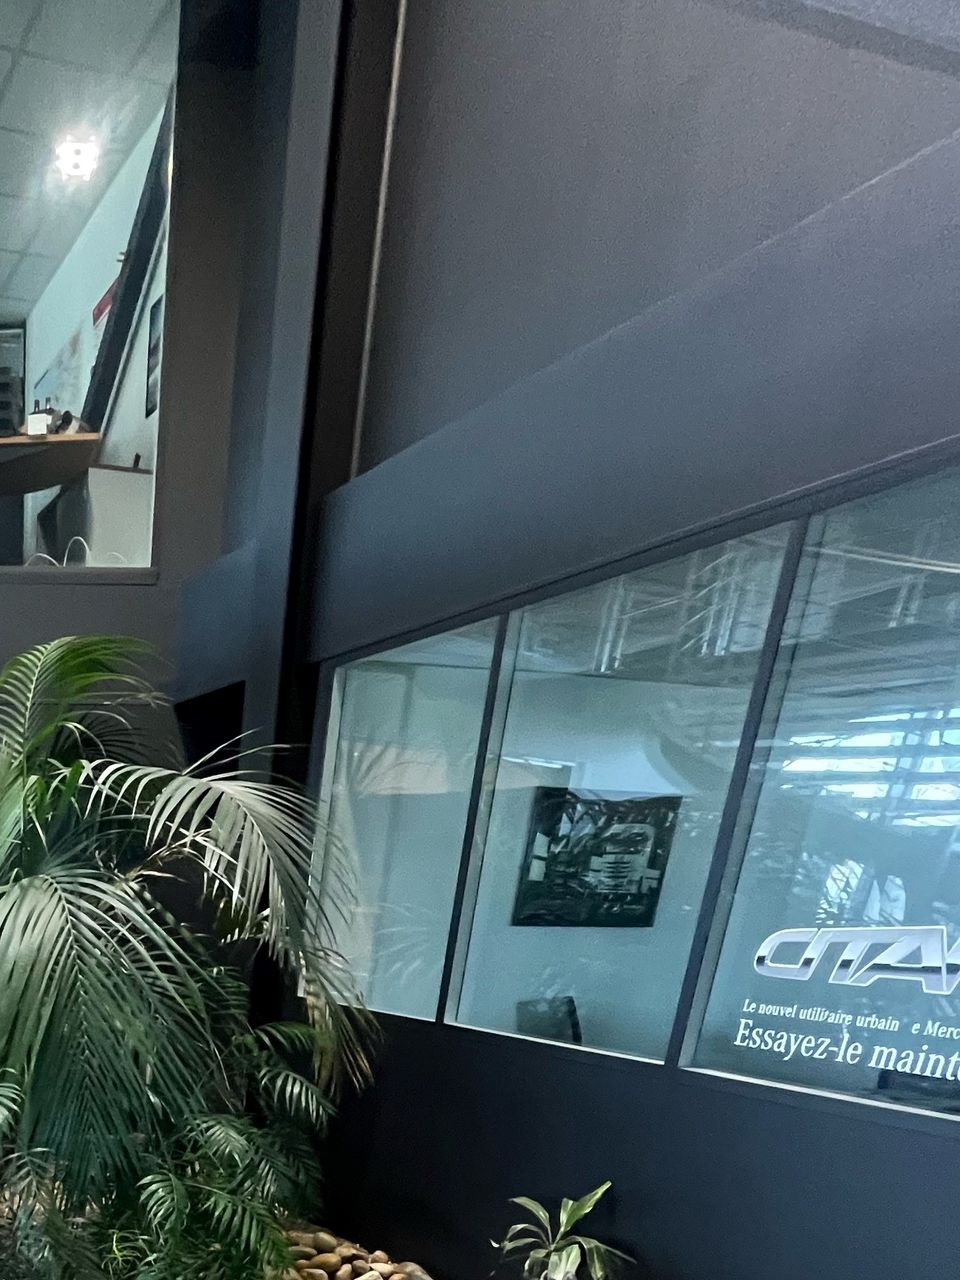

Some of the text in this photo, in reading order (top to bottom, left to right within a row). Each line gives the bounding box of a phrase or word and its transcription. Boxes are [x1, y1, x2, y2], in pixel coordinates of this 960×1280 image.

[743, 998, 756, 1013] Le
[758, 1004, 797, 1019] nouvel
[799, 1007, 852, 1025] utilitaire
[856, 1014, 900, 1032] urbain
[733, 1018, 960, 1082] Essayez-le maint
